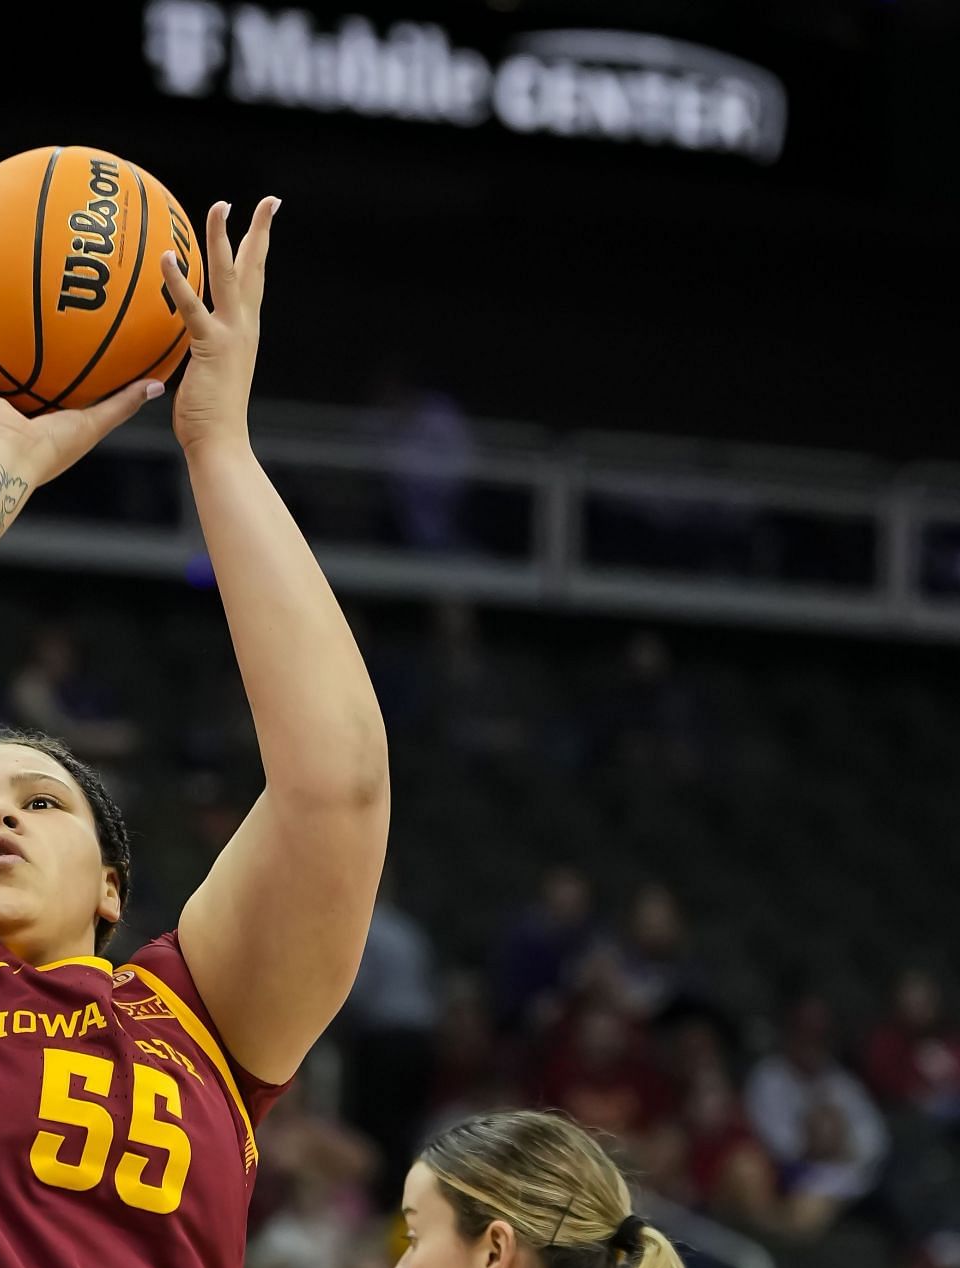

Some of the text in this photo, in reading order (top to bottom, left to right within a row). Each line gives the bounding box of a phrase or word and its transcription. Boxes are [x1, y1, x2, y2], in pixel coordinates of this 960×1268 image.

[496, 54, 768, 150] CENTER
[56, 158, 120, 314] Wilson
[29, 1047, 192, 1215] 55
